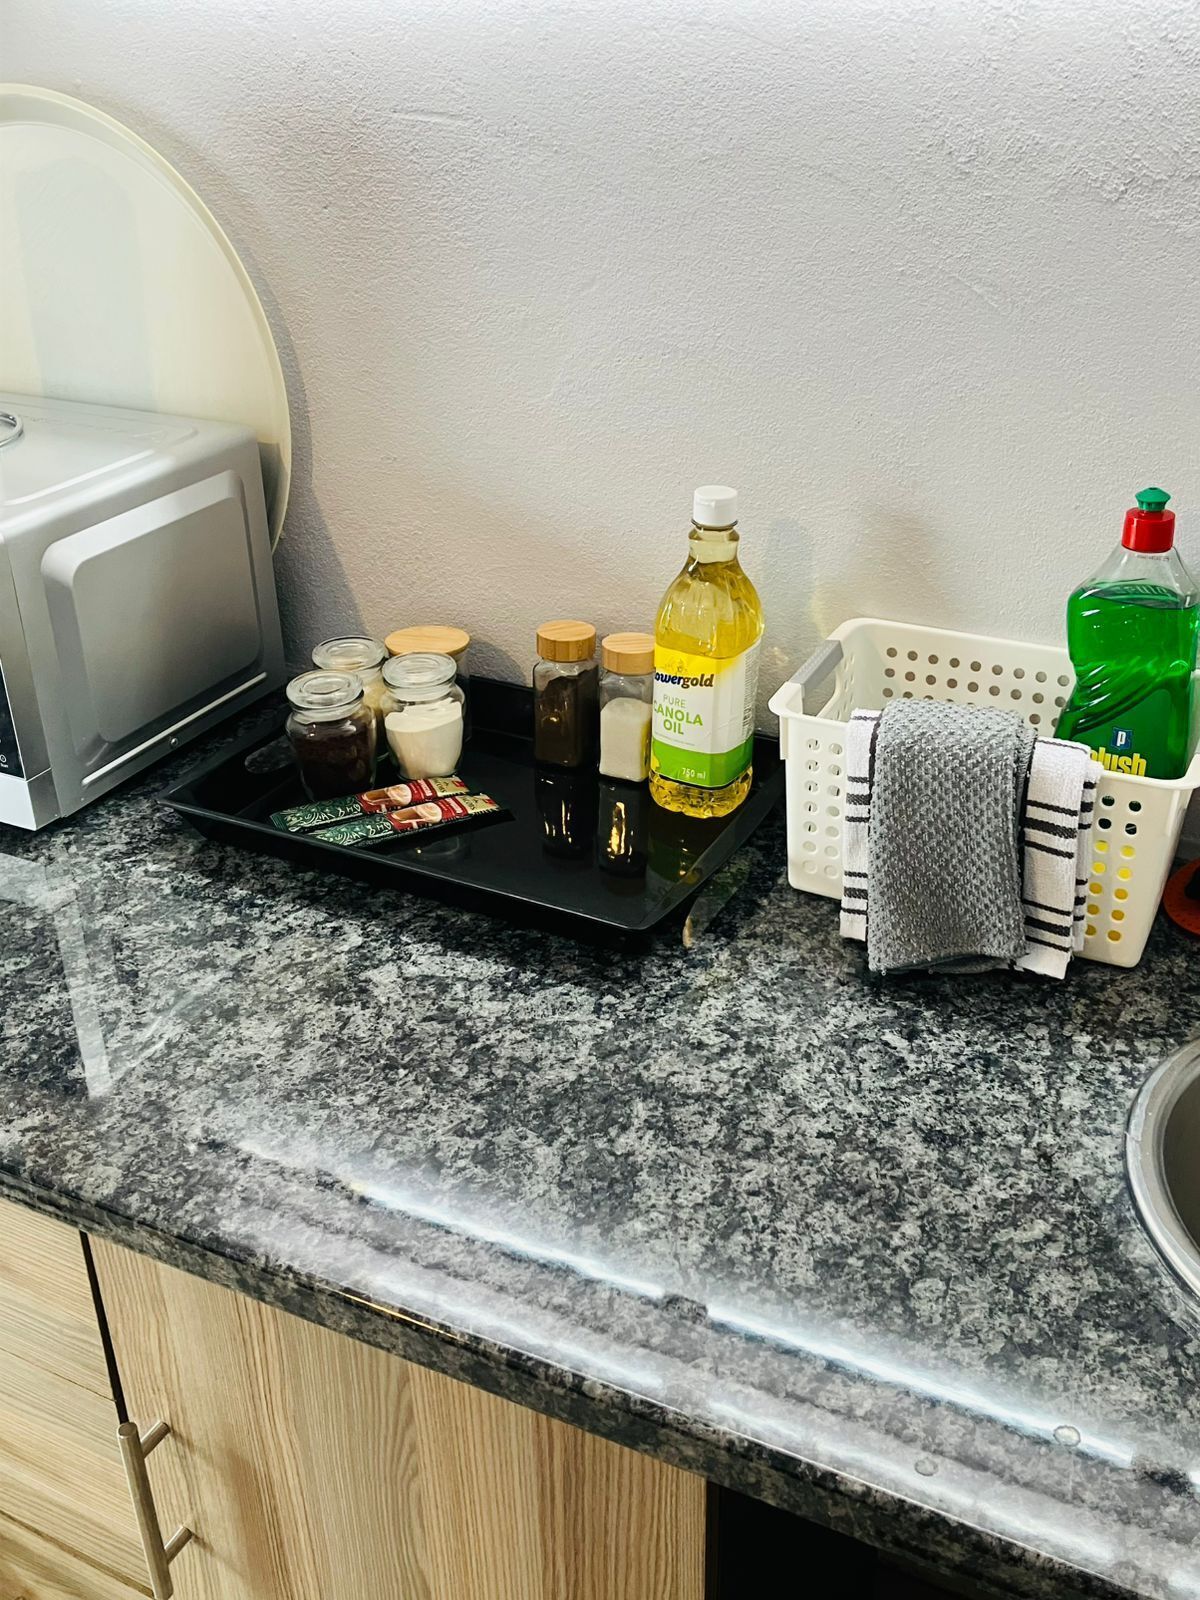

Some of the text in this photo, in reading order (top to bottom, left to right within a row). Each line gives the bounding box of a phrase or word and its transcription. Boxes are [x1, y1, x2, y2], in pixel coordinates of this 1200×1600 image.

[663, 694, 686, 709] PURE
[663, 719, 684, 735] OIL
[682, 767, 706, 780] 750 ml
